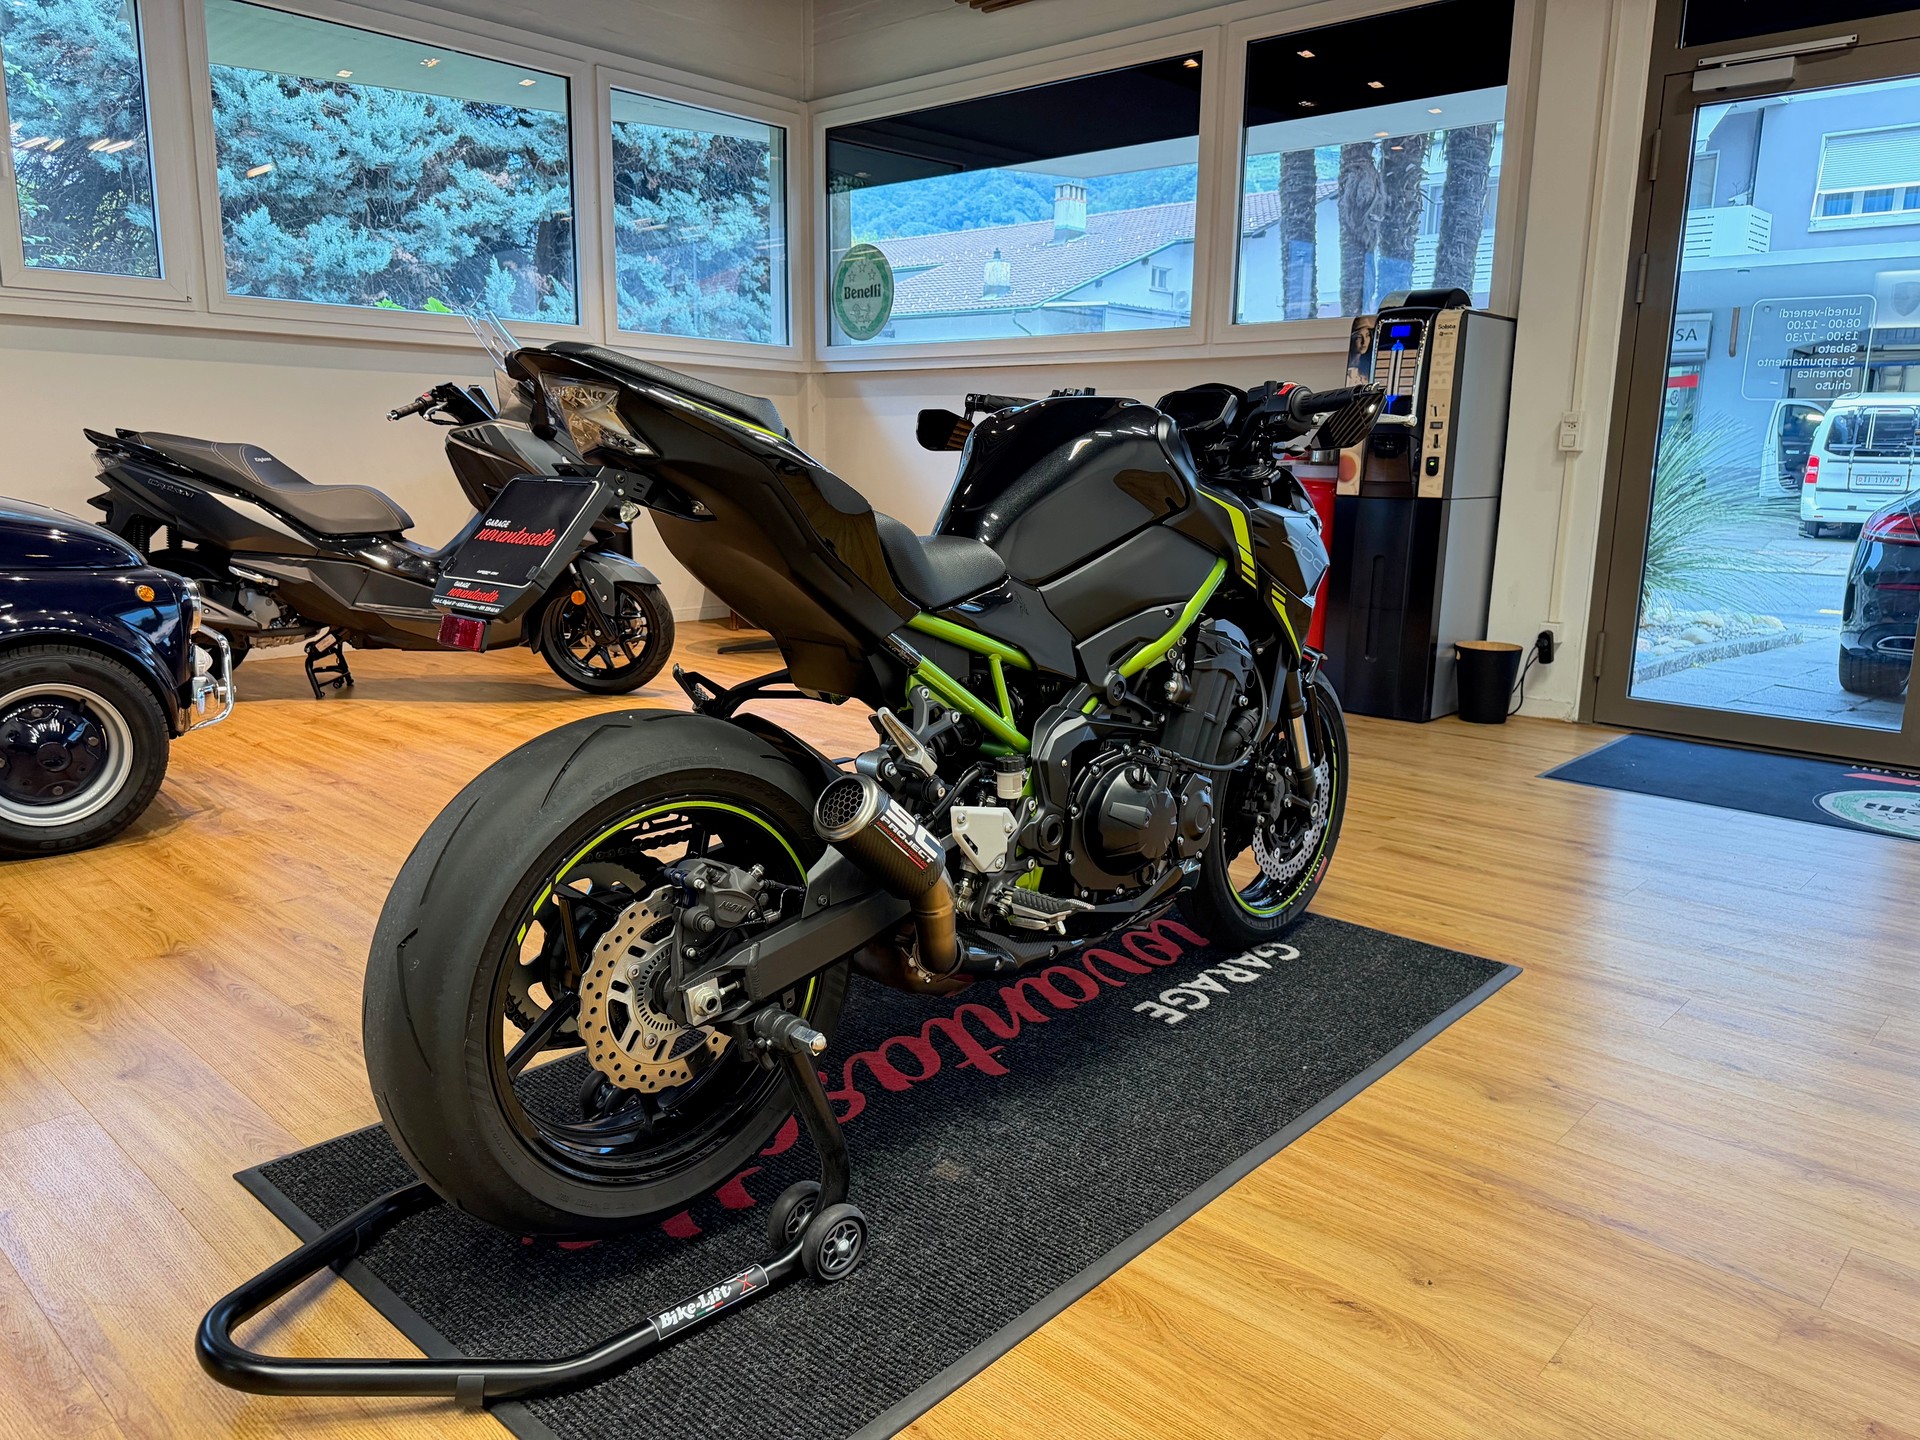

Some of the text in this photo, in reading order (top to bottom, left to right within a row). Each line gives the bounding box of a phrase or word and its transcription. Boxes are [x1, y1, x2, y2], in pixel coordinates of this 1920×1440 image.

[844, 283, 882, 300] Benelli
[1675, 328, 1698, 342] SA
[475, 527, 556, 546] novantasette
[485, 518, 511, 528] GARAGE
[879, 815, 935, 864] PROJECT
[885, 799, 942, 858] SC
[1132, 942, 1301, 1026] GARAGE
[658, 1284, 733, 1330] Bike-Lift
